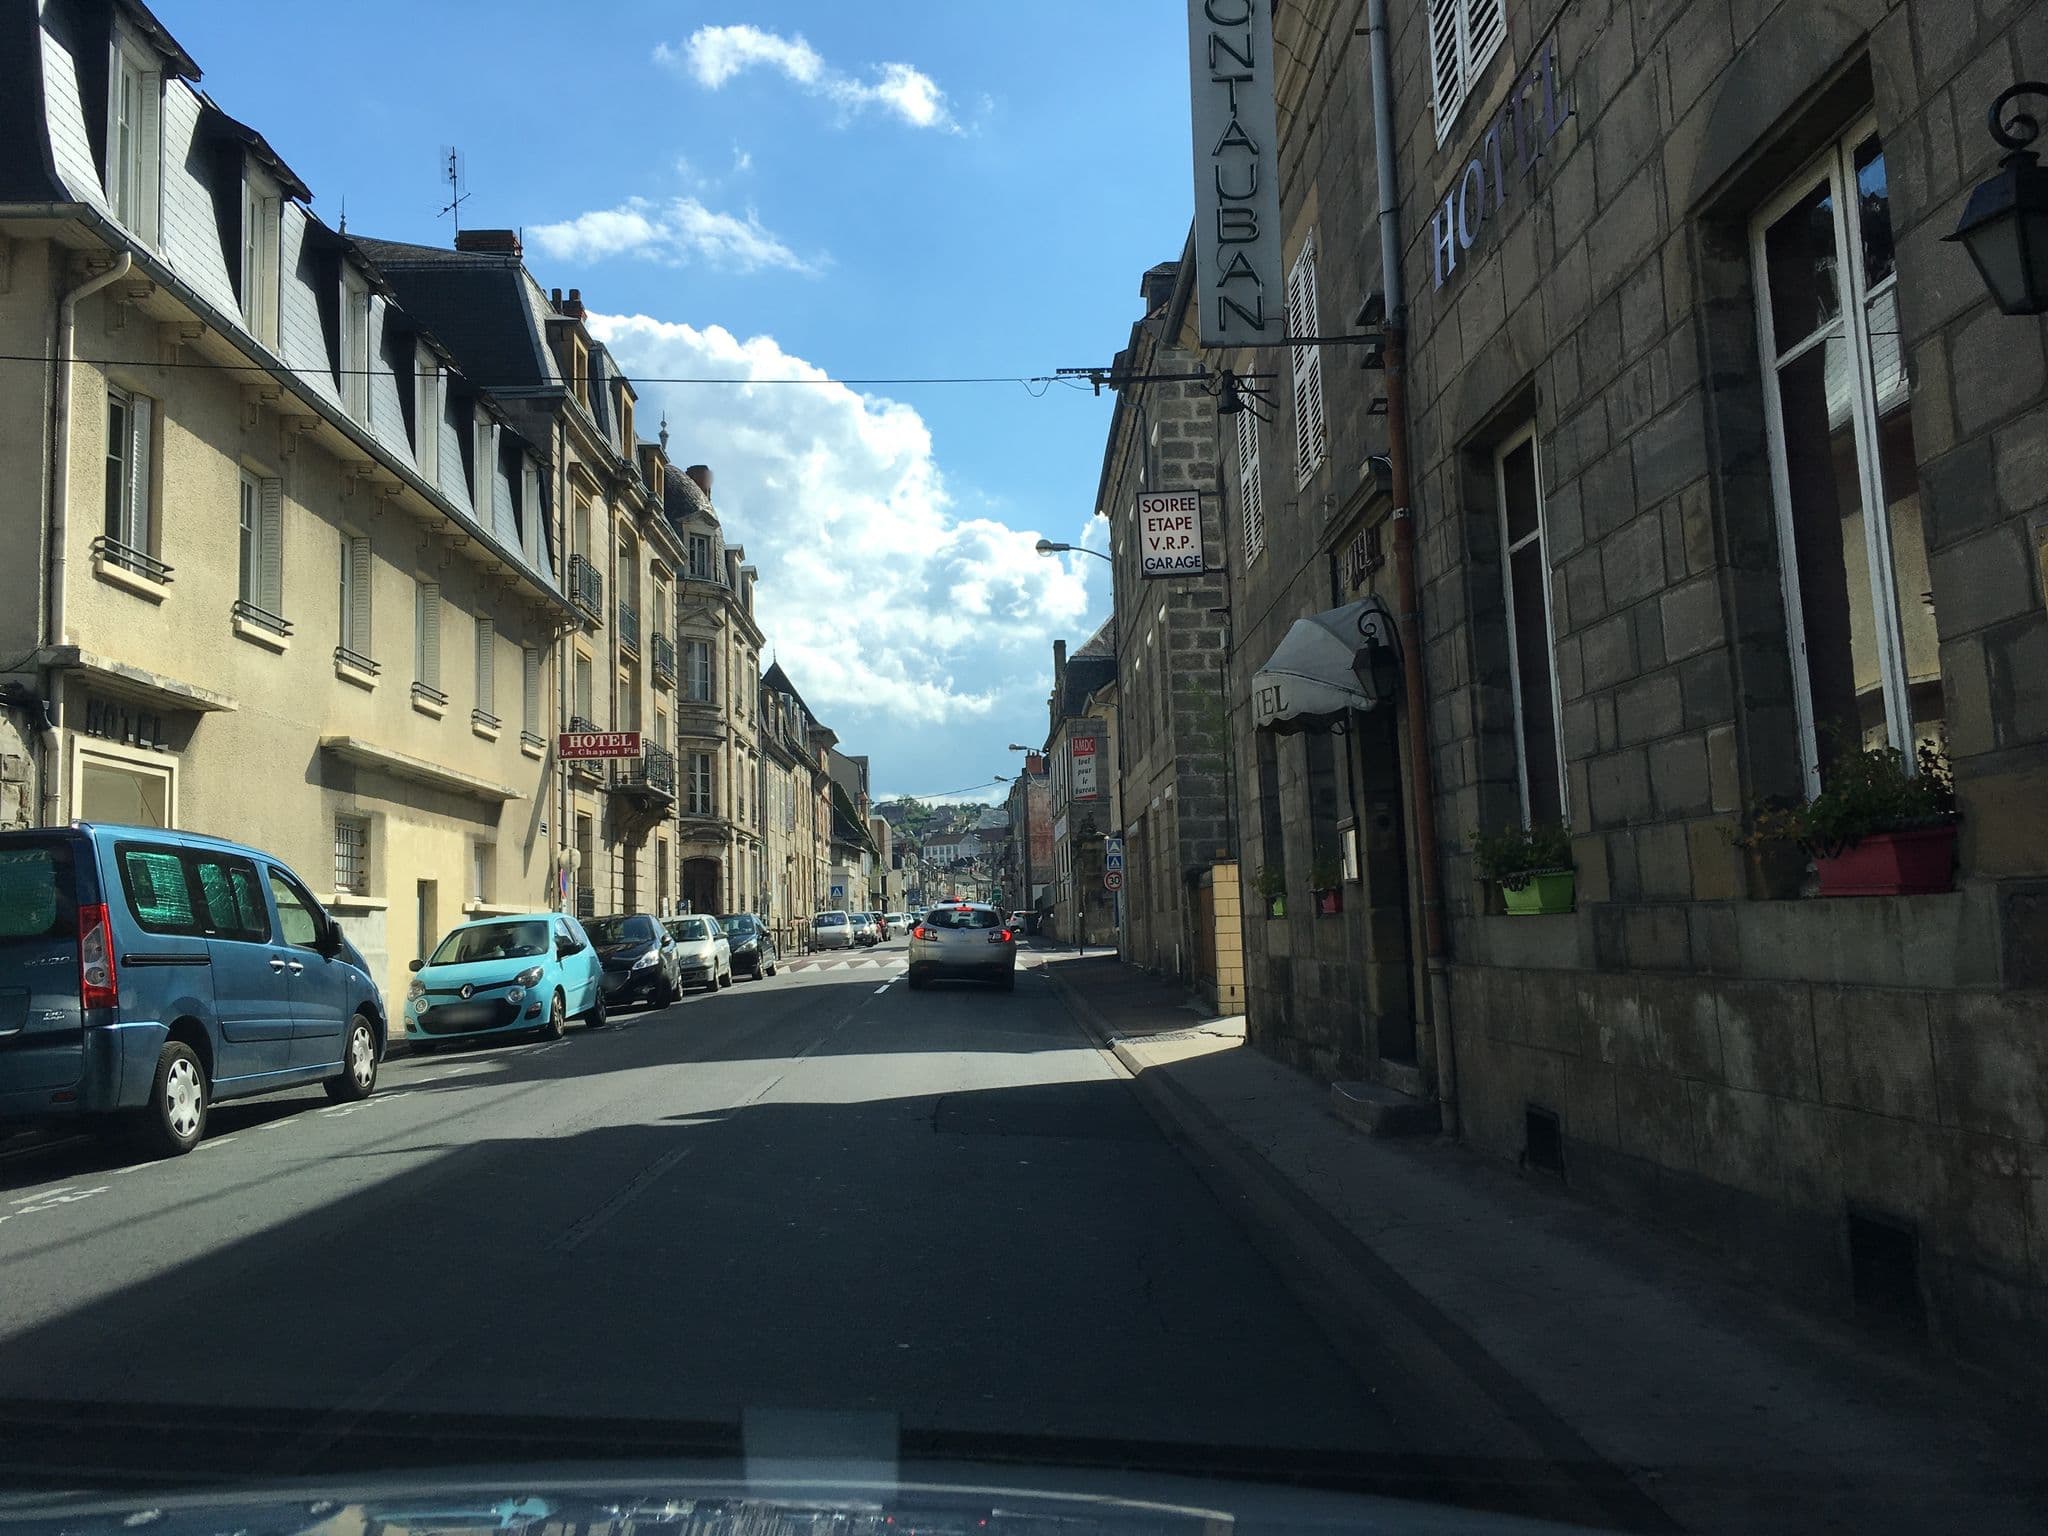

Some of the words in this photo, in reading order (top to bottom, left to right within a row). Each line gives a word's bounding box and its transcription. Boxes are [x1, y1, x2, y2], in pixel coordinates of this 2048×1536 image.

[1431, 40, 1571, 293] HOTEL
[1142, 497, 1196, 513] SOIREE
[1148, 516, 1193, 532] ETAPE
[1149, 535, 1195, 551] V.R.P.
[1145, 555, 1202, 570] GARAGE
[568, 733, 632, 748] HOTEL
[1074, 739, 1094, 752] AMDC
[578, 748, 618, 757] Chapon
[1077, 767, 1092, 777] pour
[1108, 876, 1120, 885] 30
